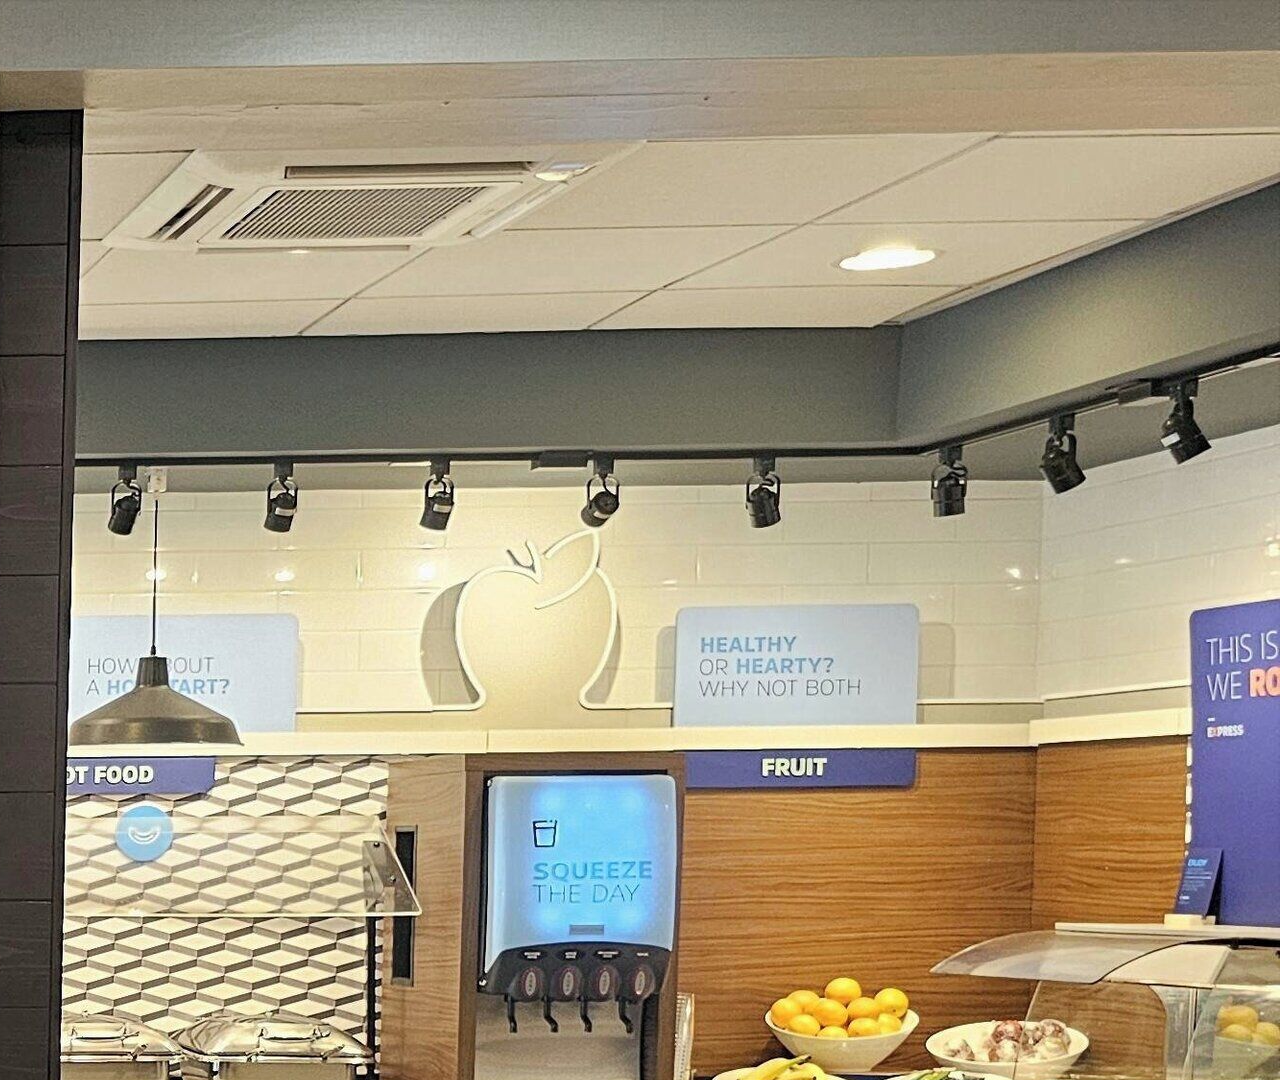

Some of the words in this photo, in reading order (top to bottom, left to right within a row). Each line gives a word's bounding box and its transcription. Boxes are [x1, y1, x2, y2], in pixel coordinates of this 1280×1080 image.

[701, 636, 797, 653] HEALTHY
[1206, 633, 1253, 666] THIS
[1261, 630, 1279, 660] IS
[88, 658, 137, 675] HOW
[699, 658, 728, 676] OR
[736, 657, 834, 674] HEARTY?
[86, 679, 100, 695] A
[107, 680, 136, 695] HO
[171, 679, 230, 695] TART?
[699, 680, 749, 697] WHY
[757, 679, 798, 697] NOT
[806, 679, 861, 696] BOTH
[1206, 671, 1242, 701] WE
[1207, 725, 1244, 737] EXPRESS
[67, 765, 89, 784] OT
[94, 765, 154, 784] FOOD
[761, 757, 828, 777] FRUIT
[533, 861, 653, 882] SQUEEZE
[532, 884, 581, 904] THE
[592, 884, 640, 904] DAY
